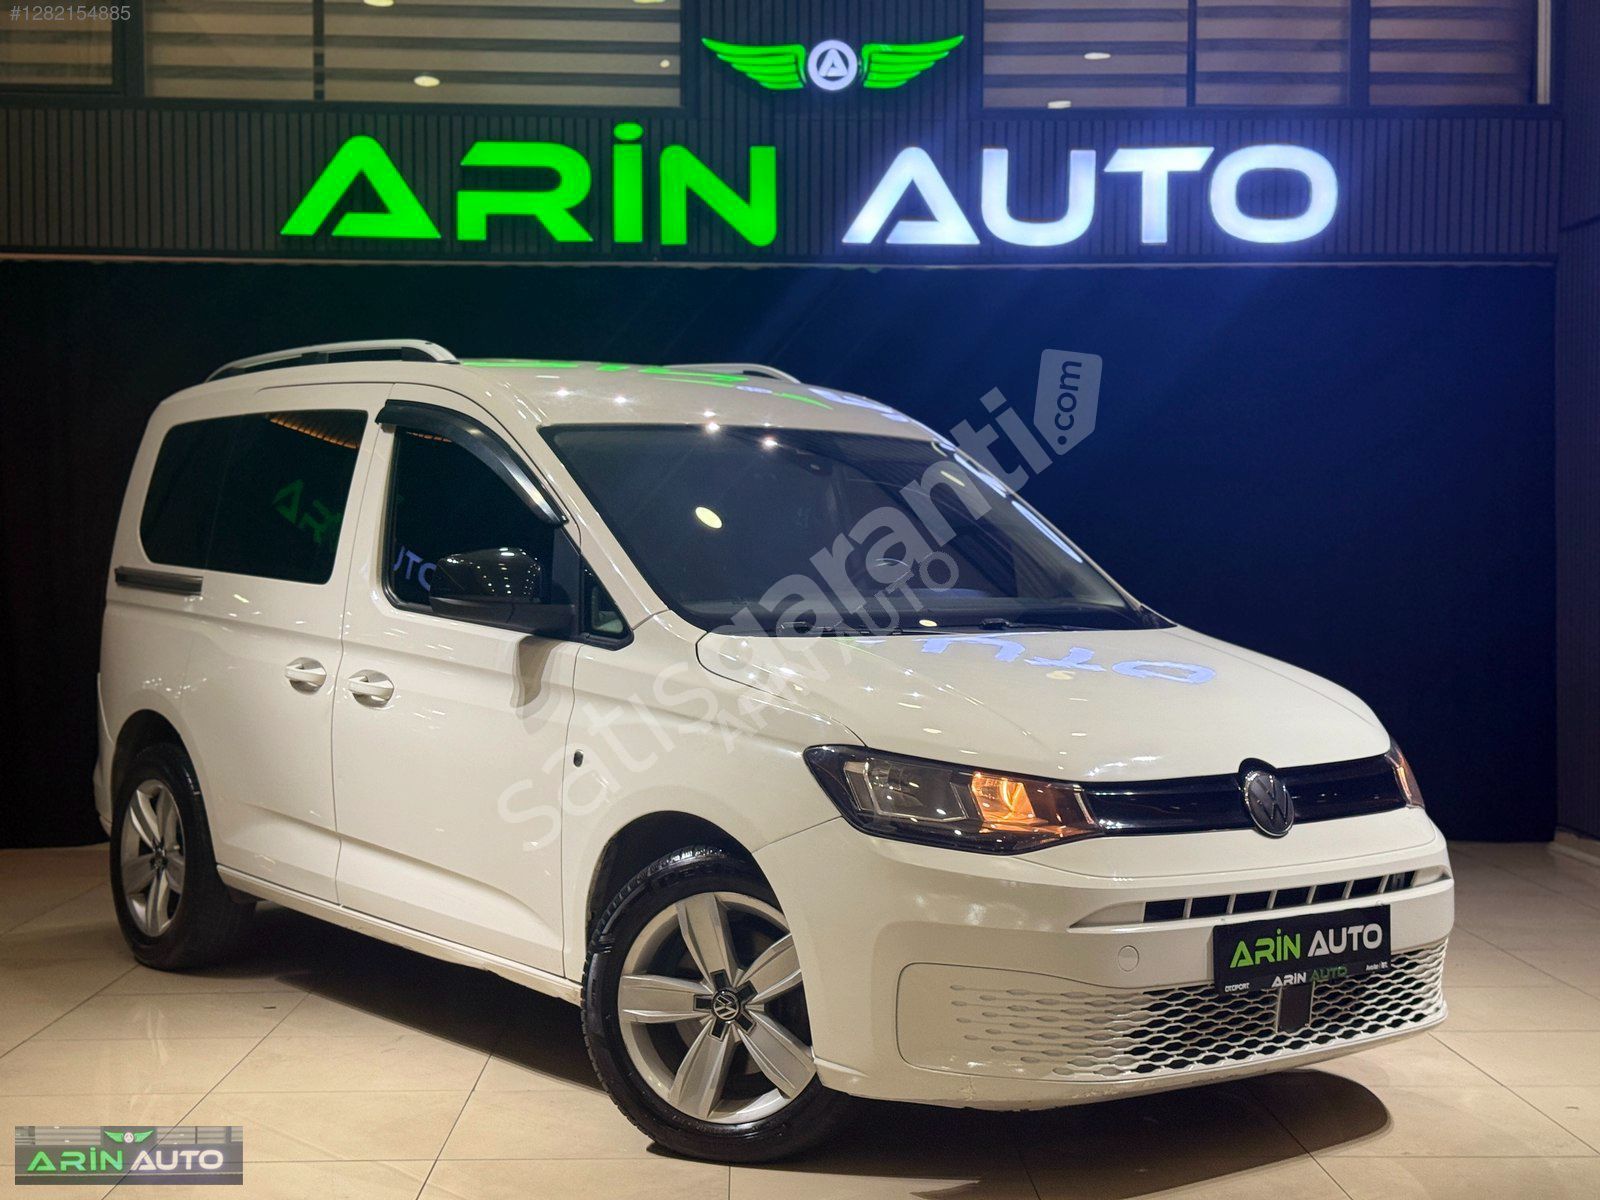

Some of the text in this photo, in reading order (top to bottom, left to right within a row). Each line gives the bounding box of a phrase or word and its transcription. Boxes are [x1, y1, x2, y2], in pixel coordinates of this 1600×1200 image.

[842, 143, 1338, 247] AUTO
[1307, 922, 1383, 958] AUTO
[1311, 966, 1348, 982] AUTO
